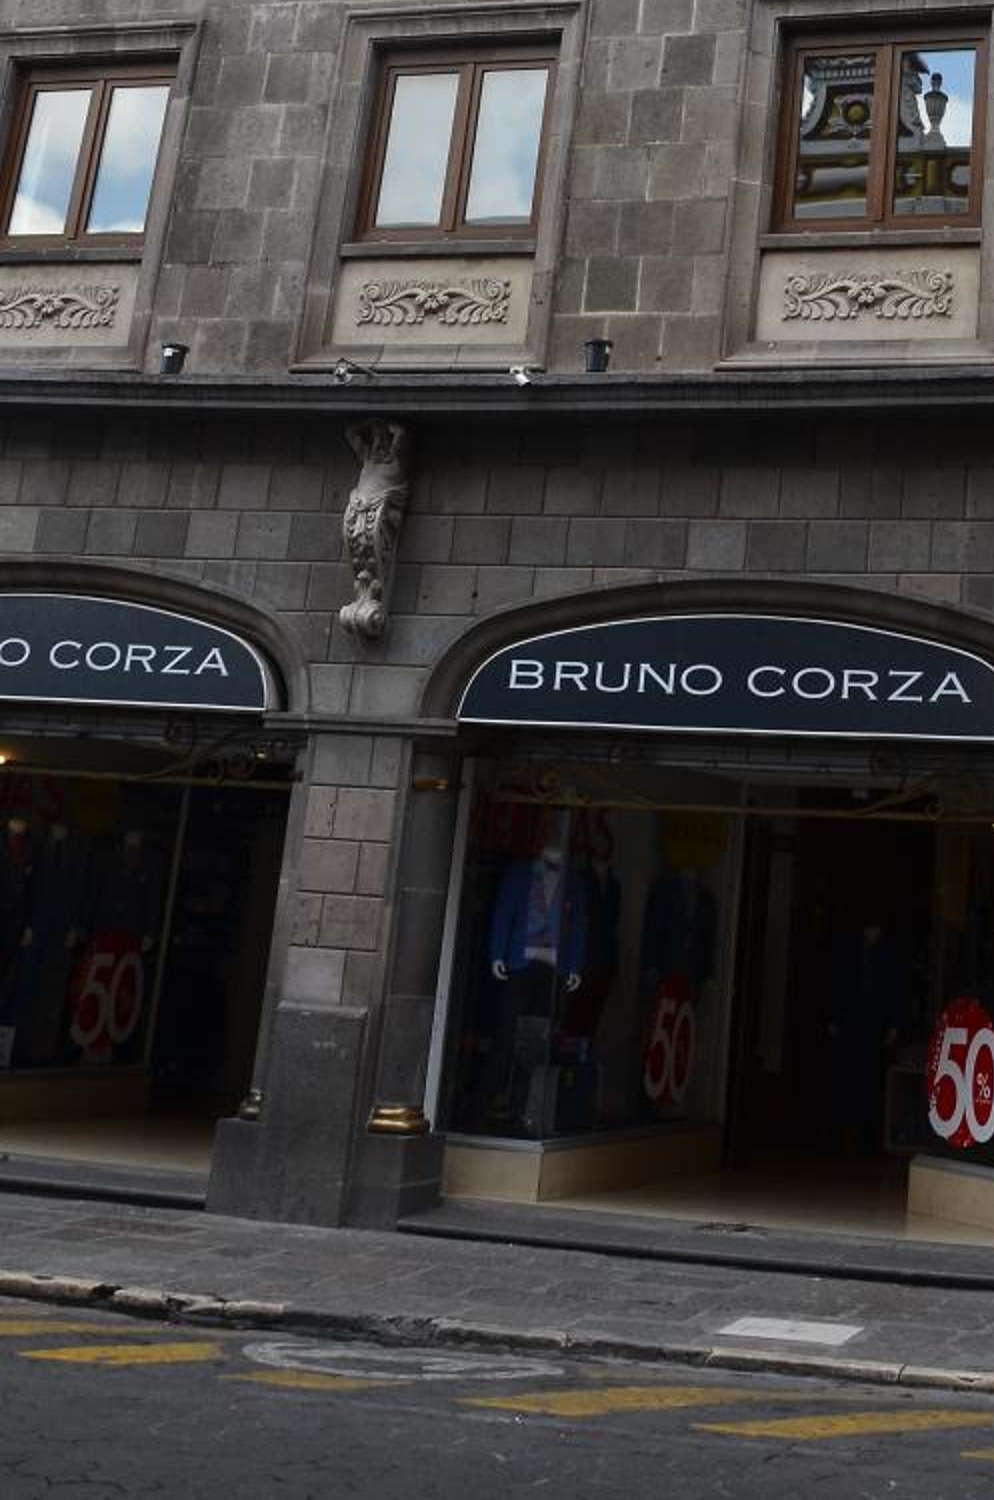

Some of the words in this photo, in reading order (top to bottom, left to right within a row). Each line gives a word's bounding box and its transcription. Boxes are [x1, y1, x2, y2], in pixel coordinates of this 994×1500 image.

[49, 640, 229, 677] CORZA
[508, 659, 723, 696] BRUNO
[746, 666, 972, 703] CORZA
[69, 951, 143, 1046] 50
[642, 996, 697, 1102] 50
